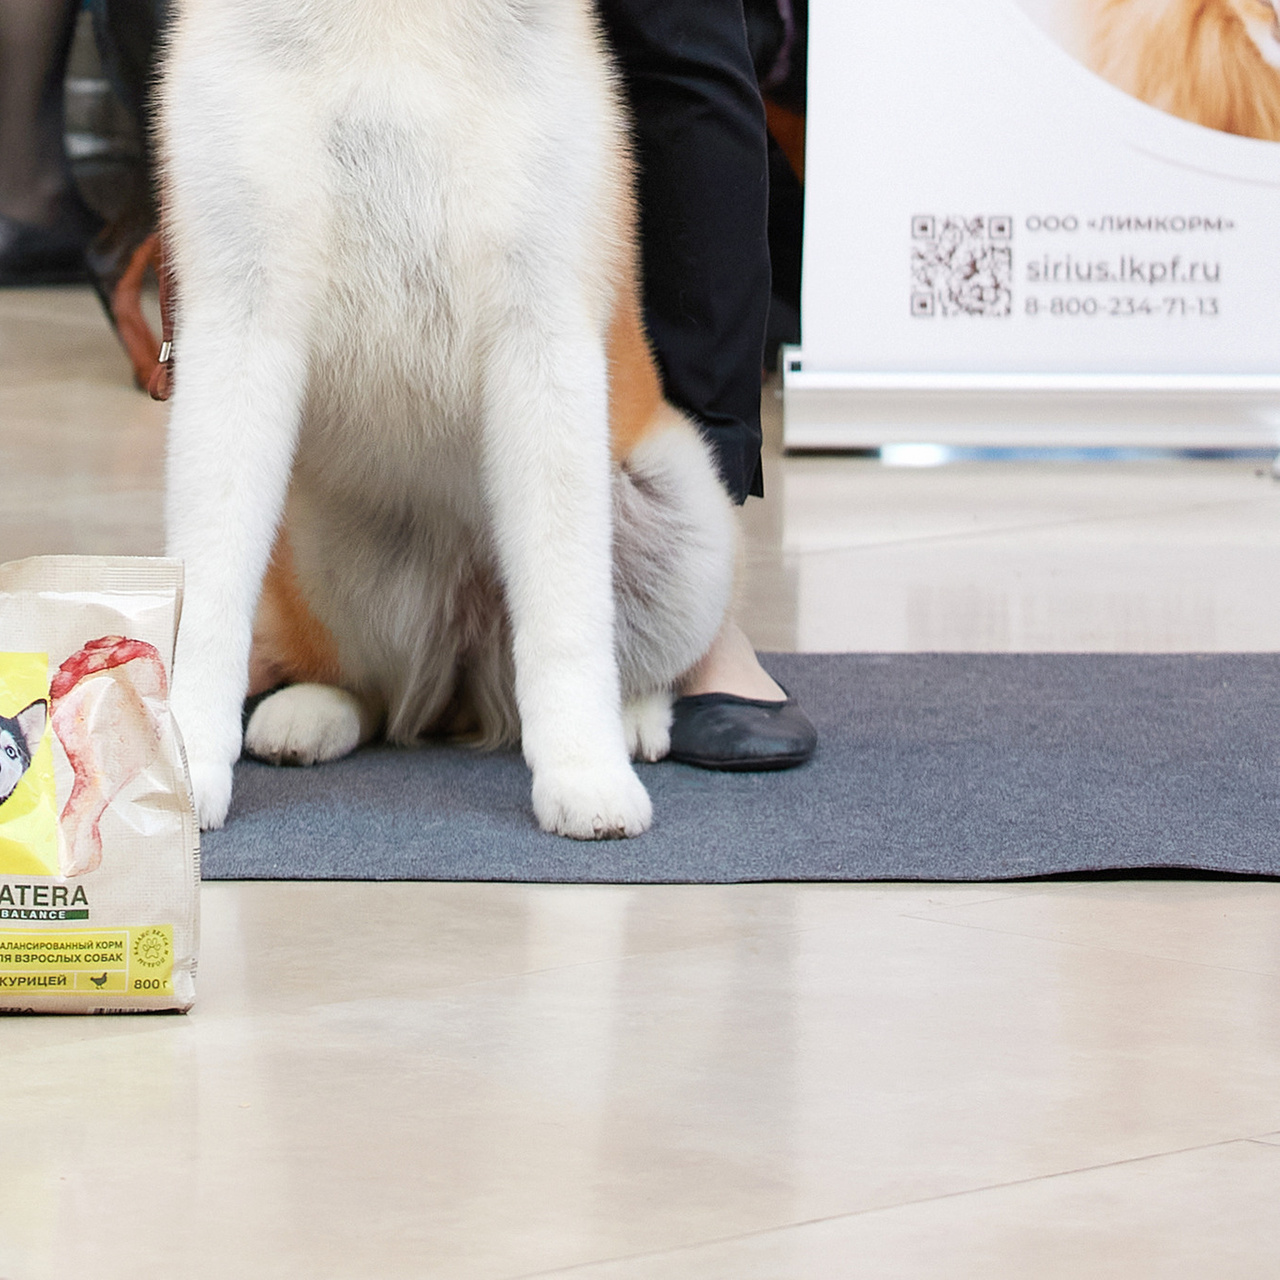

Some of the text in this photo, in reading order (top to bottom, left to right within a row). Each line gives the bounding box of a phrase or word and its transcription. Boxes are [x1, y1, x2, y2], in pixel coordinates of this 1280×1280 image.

[1025, 215, 1235, 233] ООО «ЛИМКОРМ»
[1026, 253, 1221, 286] sirius.lkpf.ru
[1024, 295, 1220, 317] 8-800-234-71-13
[1, 910, 67, 920] BALANCE
[96, 940, 123, 950] КОРМ
[16, 953, 81, 964] ВЗРОСЛЫХ
[84, 953, 123, 963] СОБАК
[134, 978, 168, 990] 800 г
